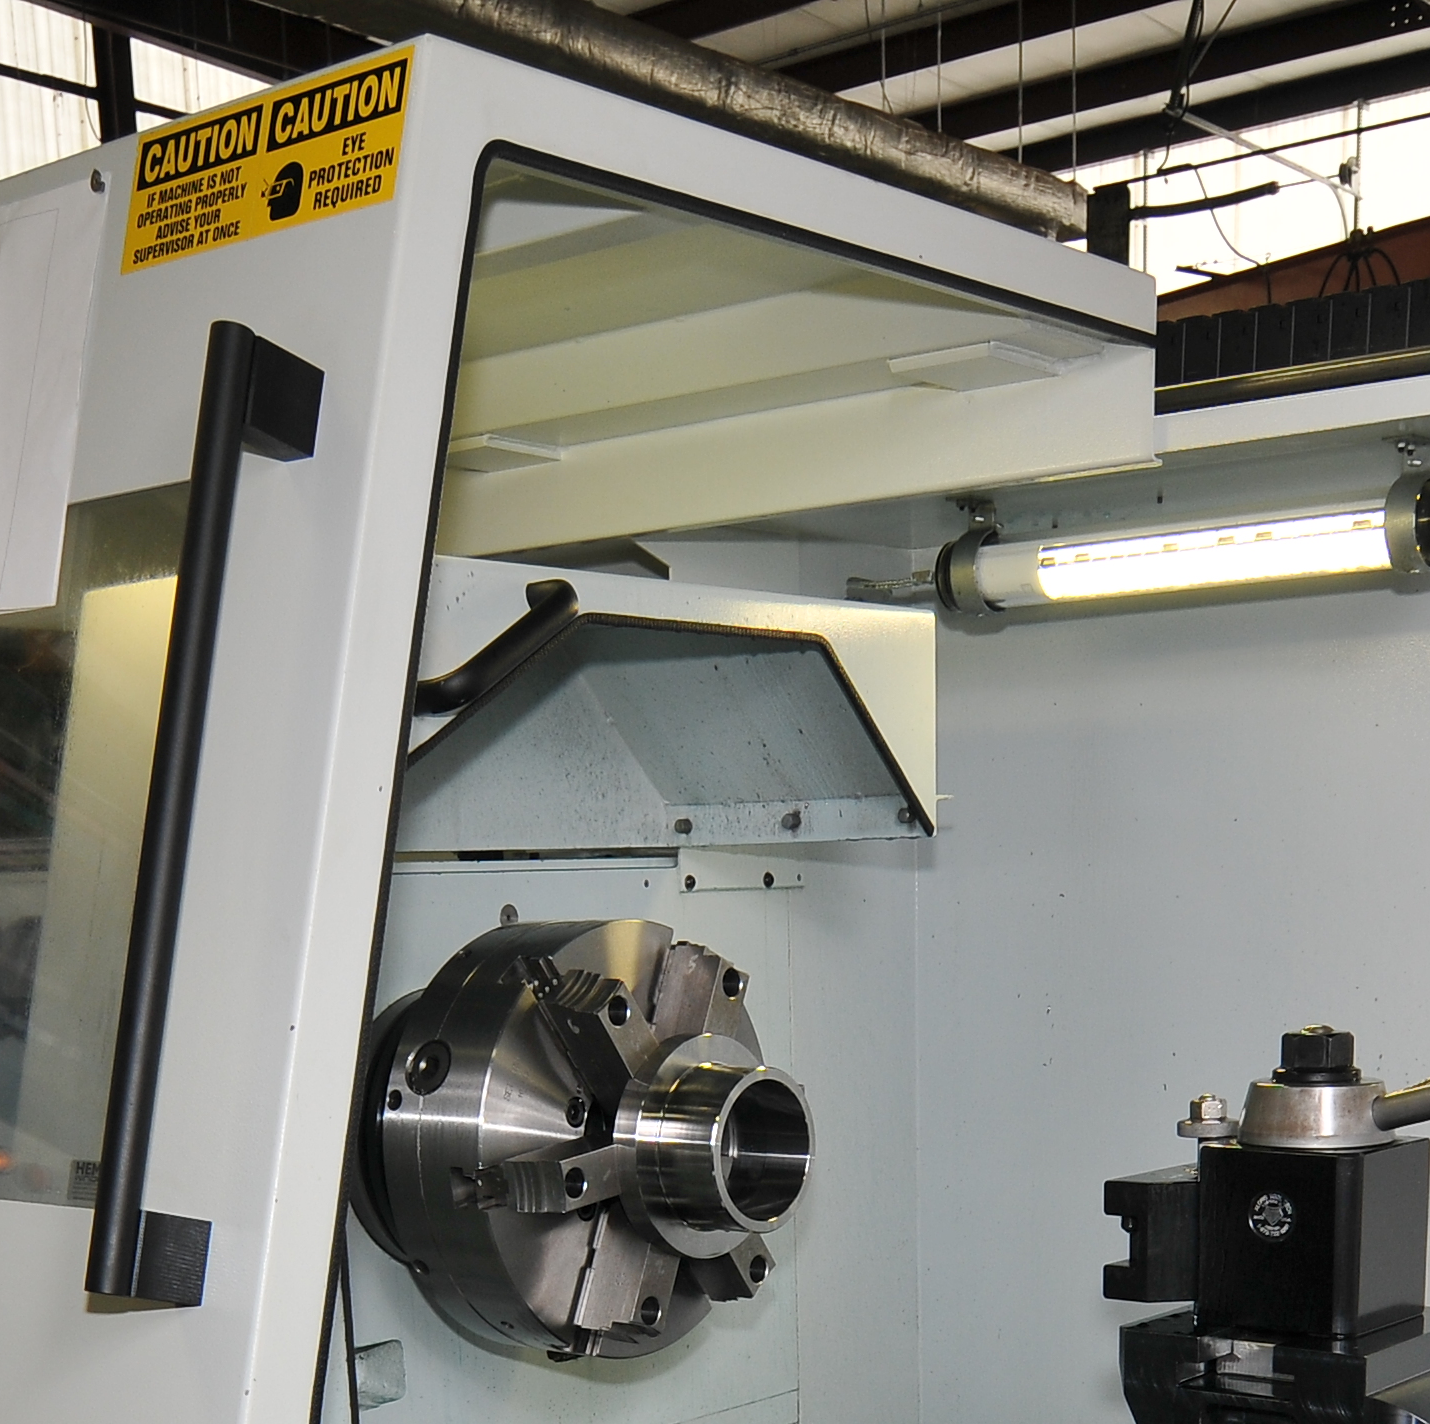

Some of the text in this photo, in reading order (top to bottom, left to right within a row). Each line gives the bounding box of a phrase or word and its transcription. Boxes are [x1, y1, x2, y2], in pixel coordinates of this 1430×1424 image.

[274, 67, 401, 144] CAUTION
[144, 111, 259, 183] CAUTION
[342, 132, 366, 157] EYE
[147, 166, 242, 208] IF MACHINE IS NOT
[308, 147, 395, 190] PROTECTION
[136, 182, 248, 229] OPERATING PROPERLY
[313, 175, 382, 210] REQUIRED
[132, 220, 240, 265] SUPERVISOR AT ONCE
[155, 209, 221, 241] ADVISE YOUR
